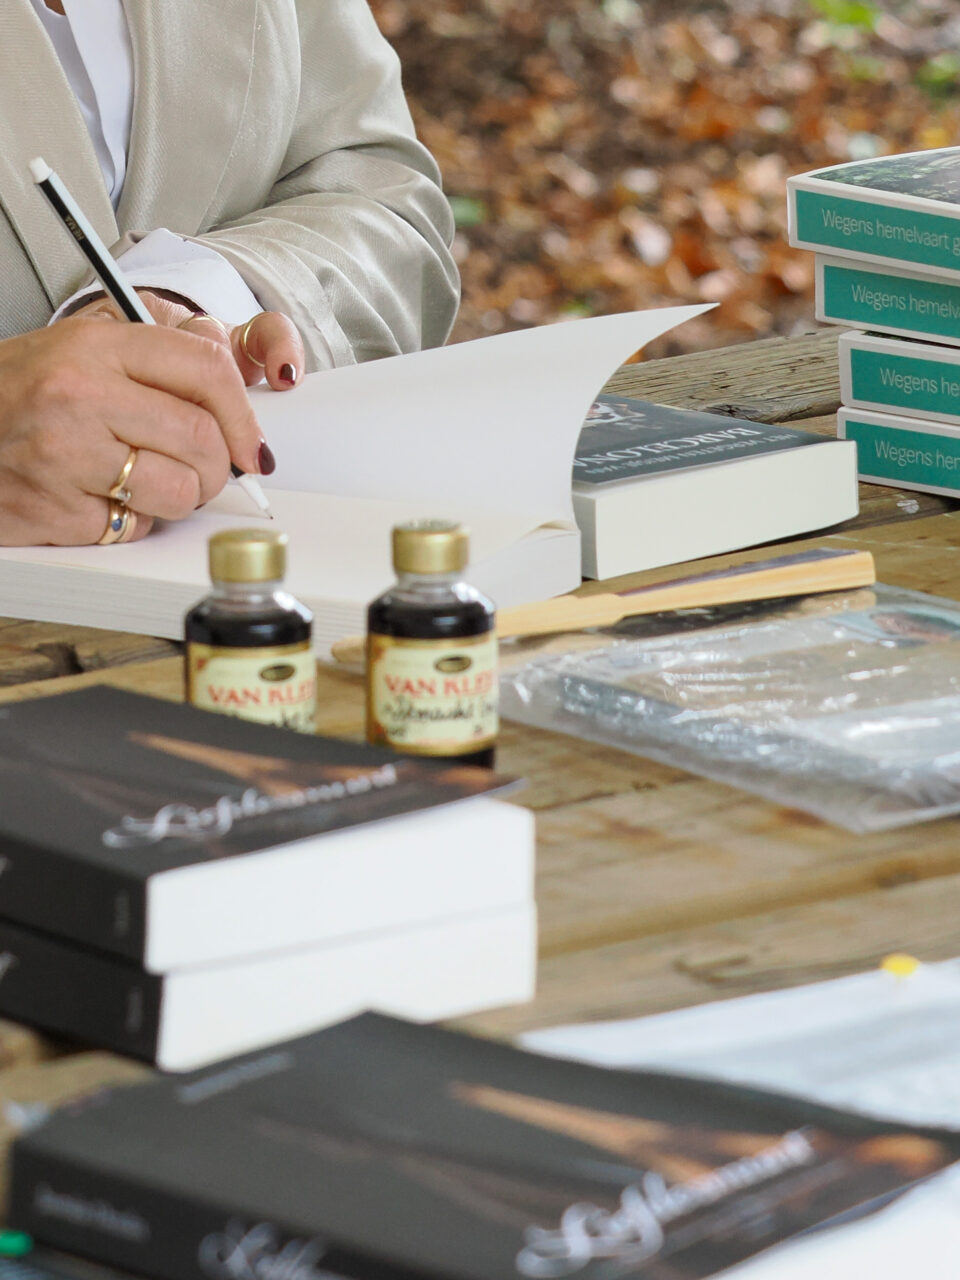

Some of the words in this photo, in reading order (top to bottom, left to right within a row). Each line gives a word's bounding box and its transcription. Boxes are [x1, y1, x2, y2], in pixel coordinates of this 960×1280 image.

[822, 208, 874, 236] Wegens
[876, 218, 950, 250] hemelvaart
[851, 284, 906, 311] Wegens
[880, 367, 938, 394] Wegens
[874, 439, 933, 467] Wegens
[207, 684, 262, 707] VAN
[384, 673, 437, 697] VAN
